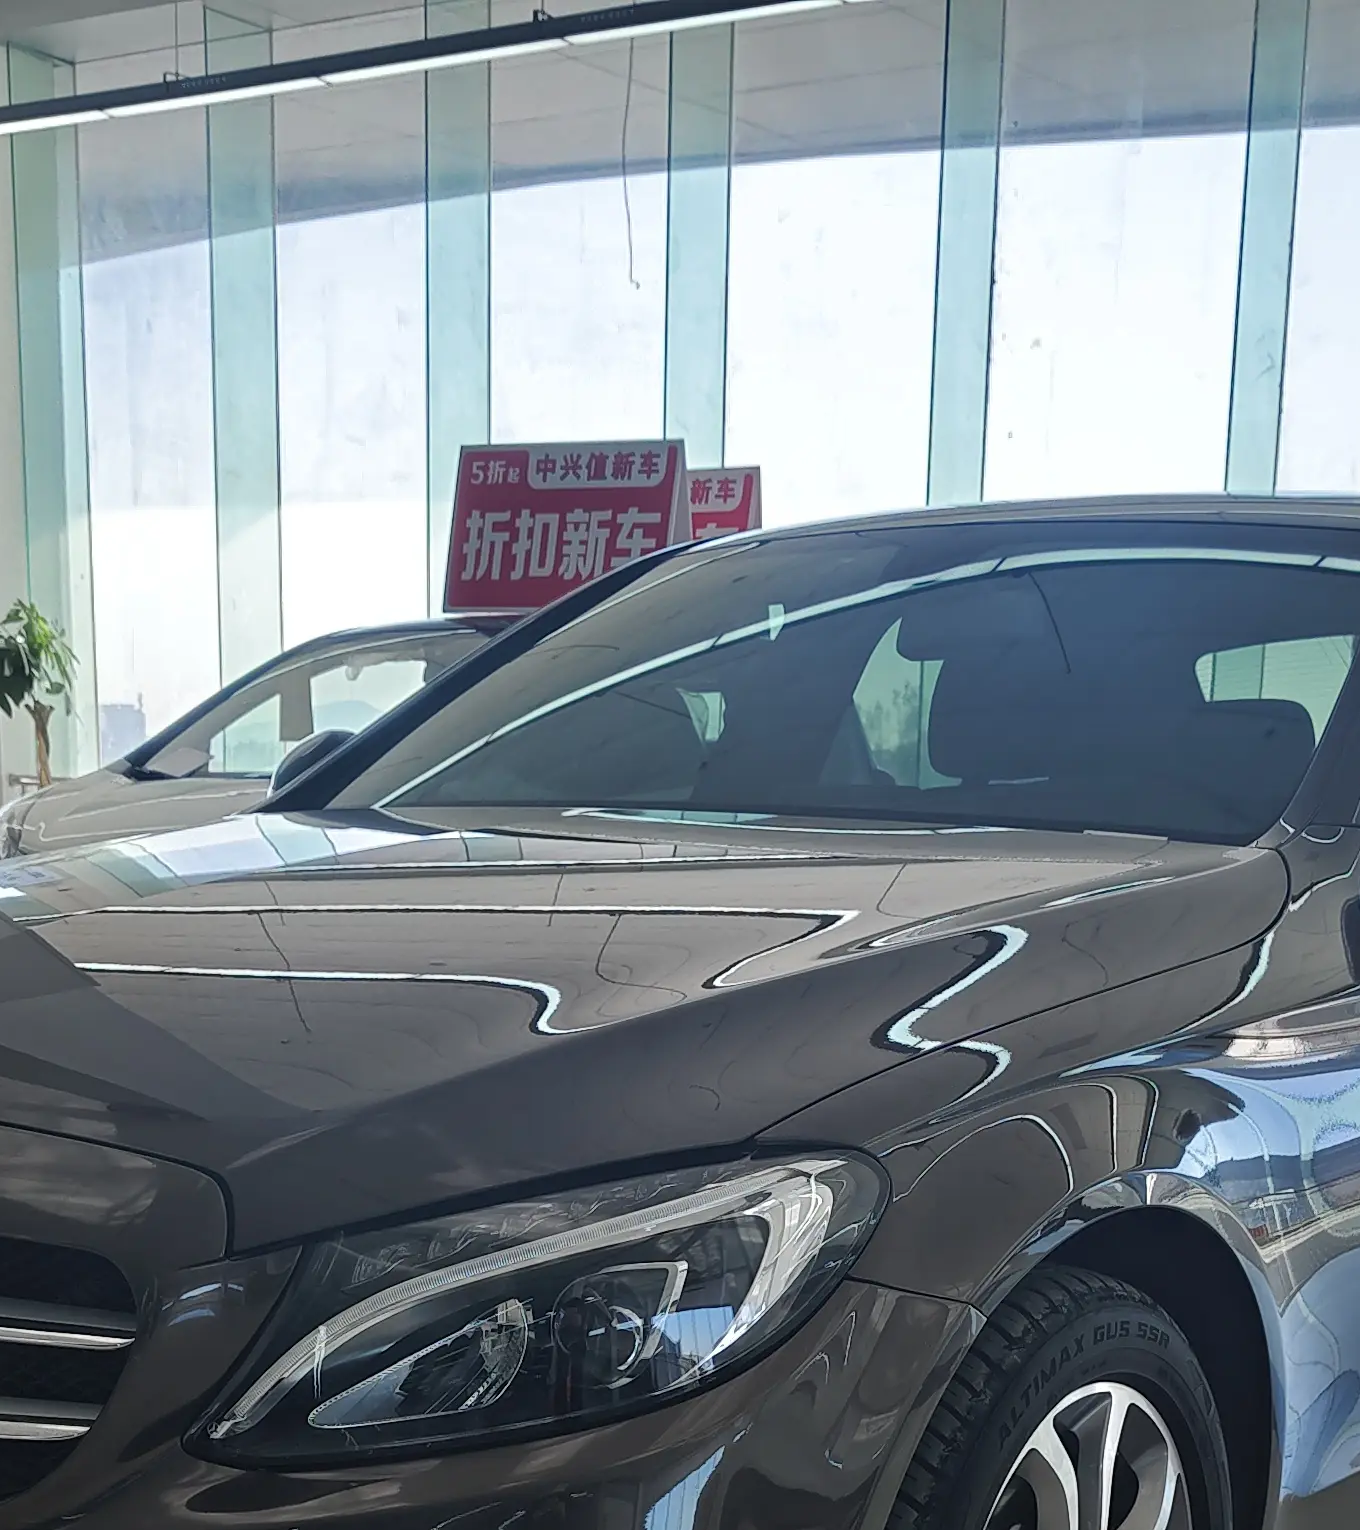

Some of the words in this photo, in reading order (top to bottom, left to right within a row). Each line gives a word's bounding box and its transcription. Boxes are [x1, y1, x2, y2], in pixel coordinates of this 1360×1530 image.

[470, 460, 520, 485] 5折起
[536, 451, 661, 482] 中兴值新车
[690, 476, 737, 505] 新车
[461, 507, 662, 581] 折扣新车
[998, 1333, 1086, 1451] ALTIMAX
